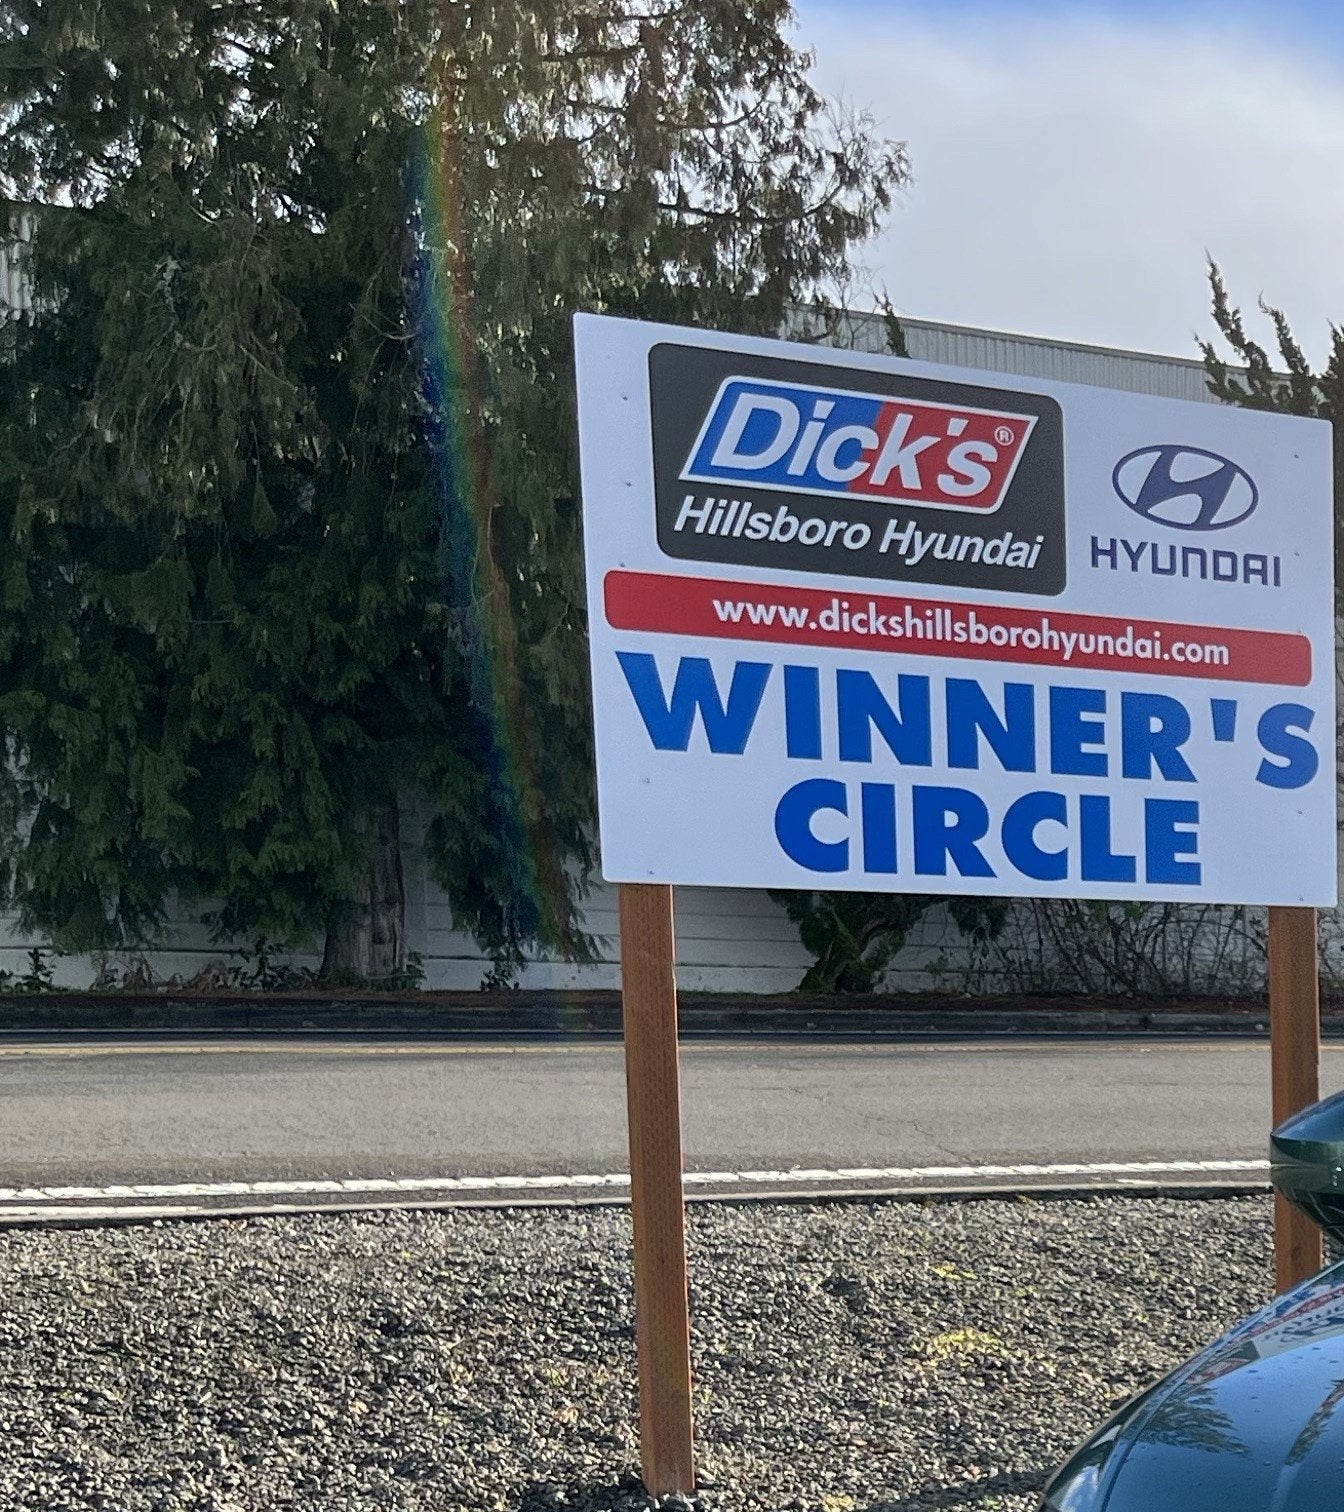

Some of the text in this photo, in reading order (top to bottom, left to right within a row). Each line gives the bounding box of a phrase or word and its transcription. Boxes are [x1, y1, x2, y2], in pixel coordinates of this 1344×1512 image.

[673, 495, 1043, 569] Hillsboro Hyundai
[1091, 536, 1281, 587] HYUNDAI
[712, 598, 1229, 667] www.dickshillsborohyundai.com
[615, 650, 1319, 789] WINNER'S
[774, 777, 1202, 886] CIRCLE
